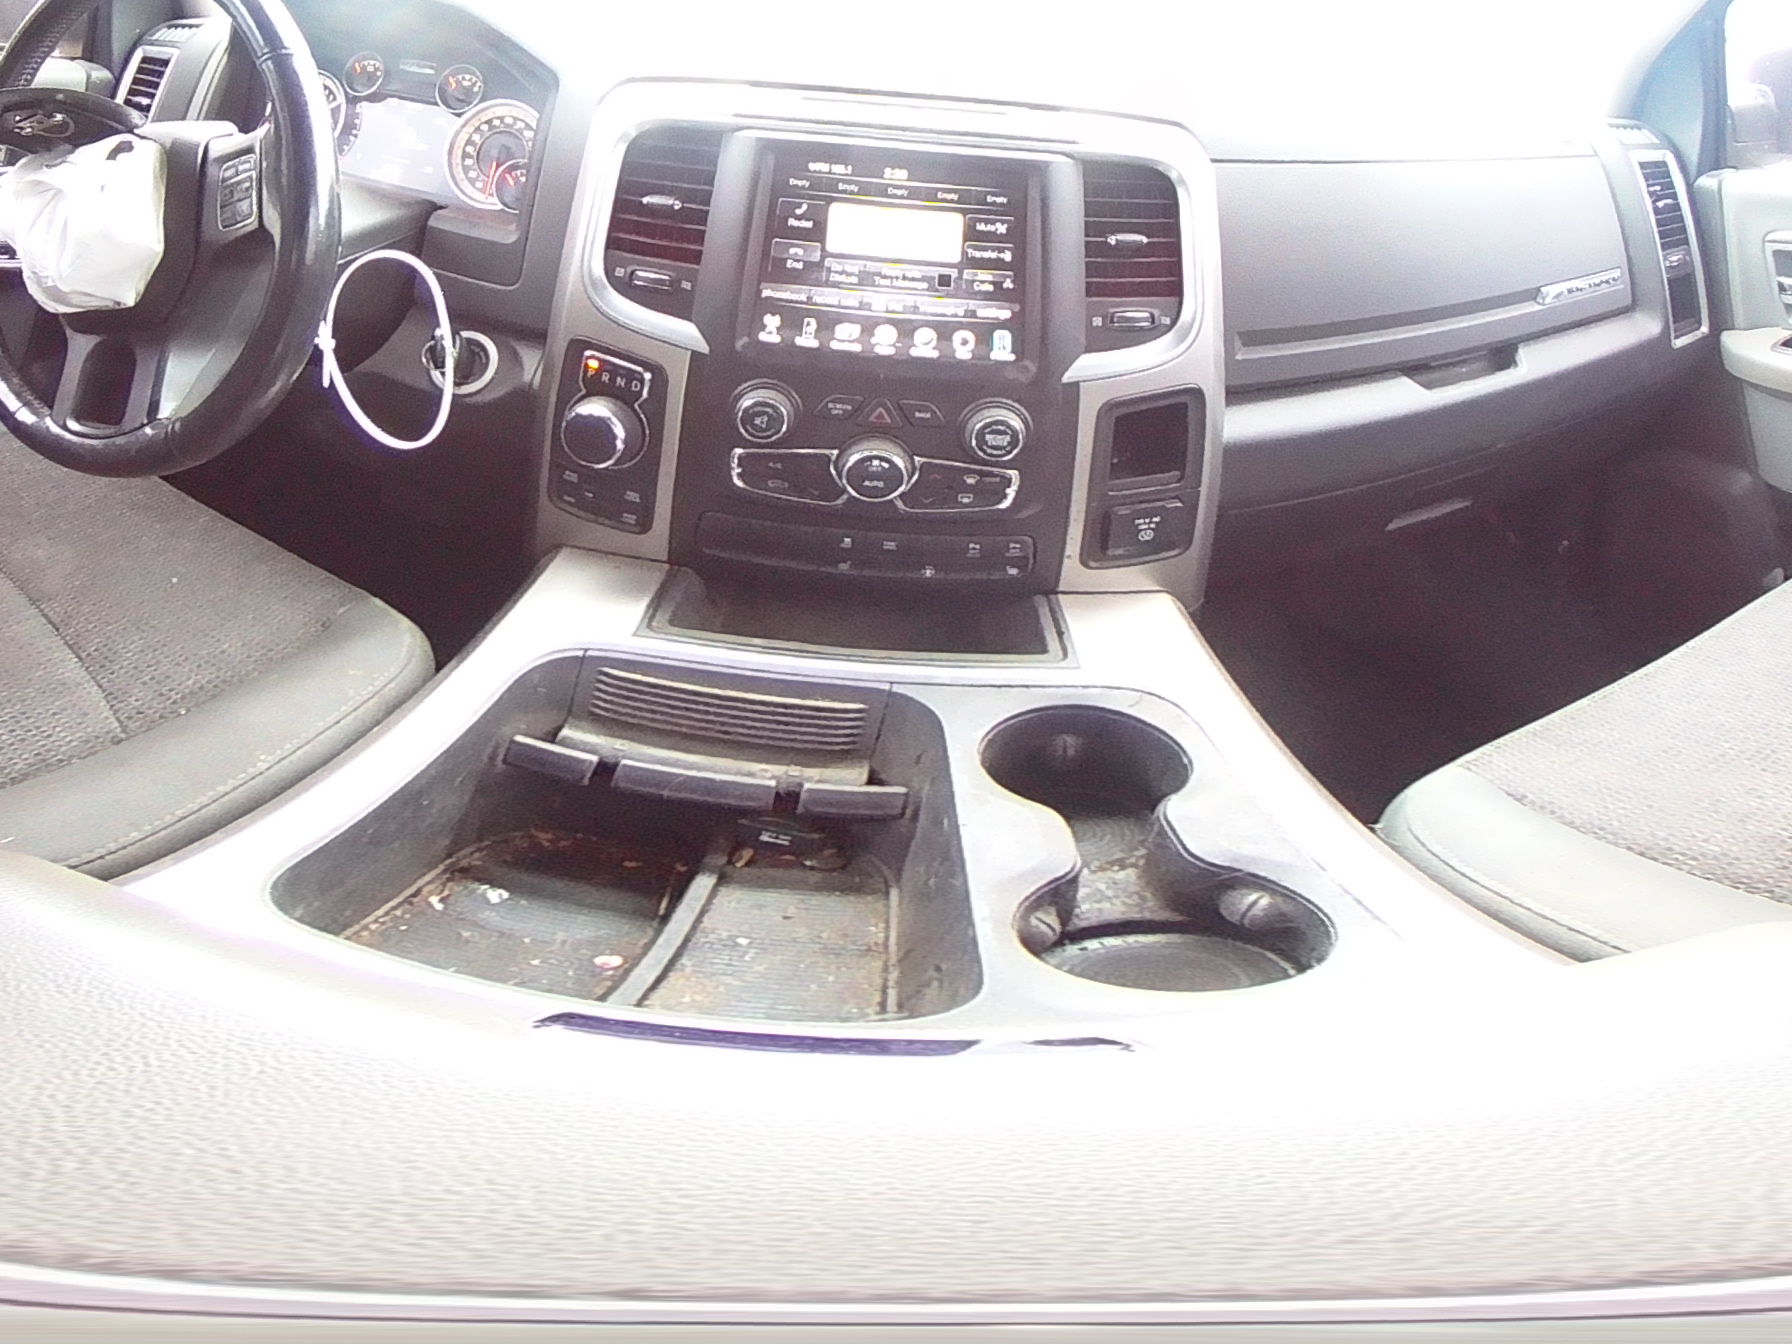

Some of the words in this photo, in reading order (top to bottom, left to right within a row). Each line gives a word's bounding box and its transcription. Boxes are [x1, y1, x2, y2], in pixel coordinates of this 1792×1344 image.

[789, 178, 811, 189] Empty
[838, 183, 860, 194] Empty
[887, 187, 910, 197] Empty
[937, 191, 959, 202] Empty
[986, 195, 1009, 205] Empty
[785, 259, 804, 270] End
[586, 368, 596, 378] P
[601, 373, 611, 384] R
[615, 376, 626, 388] N
[631, 380, 642, 392] D
[862, 479, 885, 489] AUTO
